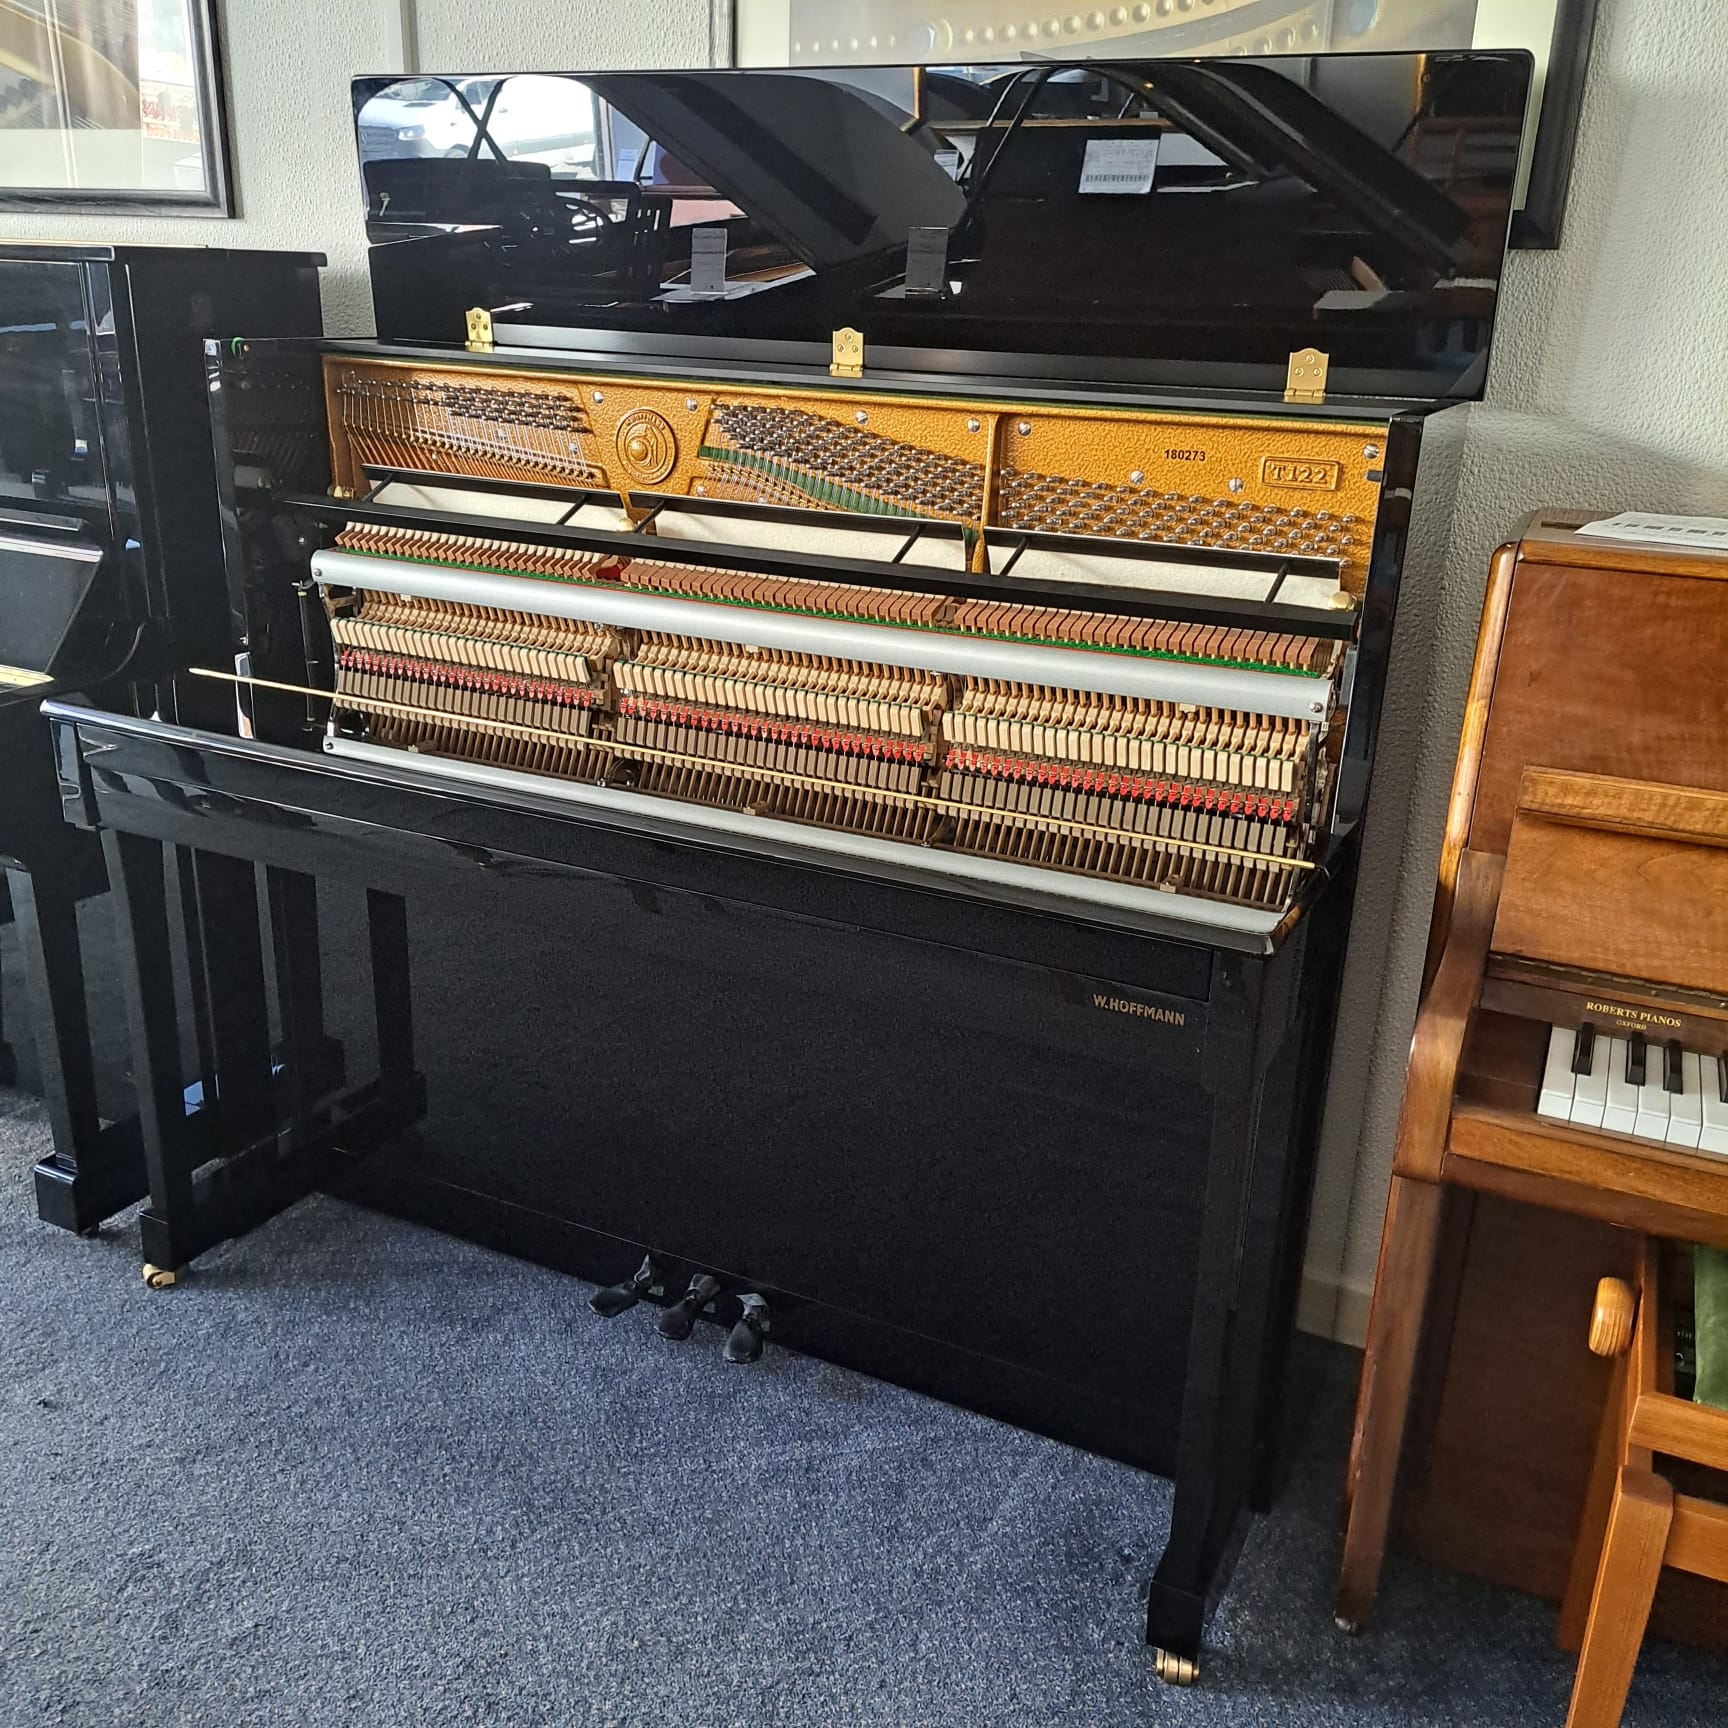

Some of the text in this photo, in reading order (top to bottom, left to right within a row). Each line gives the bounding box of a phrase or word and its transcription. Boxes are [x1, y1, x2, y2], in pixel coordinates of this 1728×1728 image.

[1164, 449, 1206, 462] 180273
[1270, 463, 1329, 485] T122
[1092, 993, 1185, 1027] W.HOFFMANN
[1585, 1001, 1682, 1028] ROBERTS PIANOS
[1615, 1019, 1647, 1031] OXFORD
